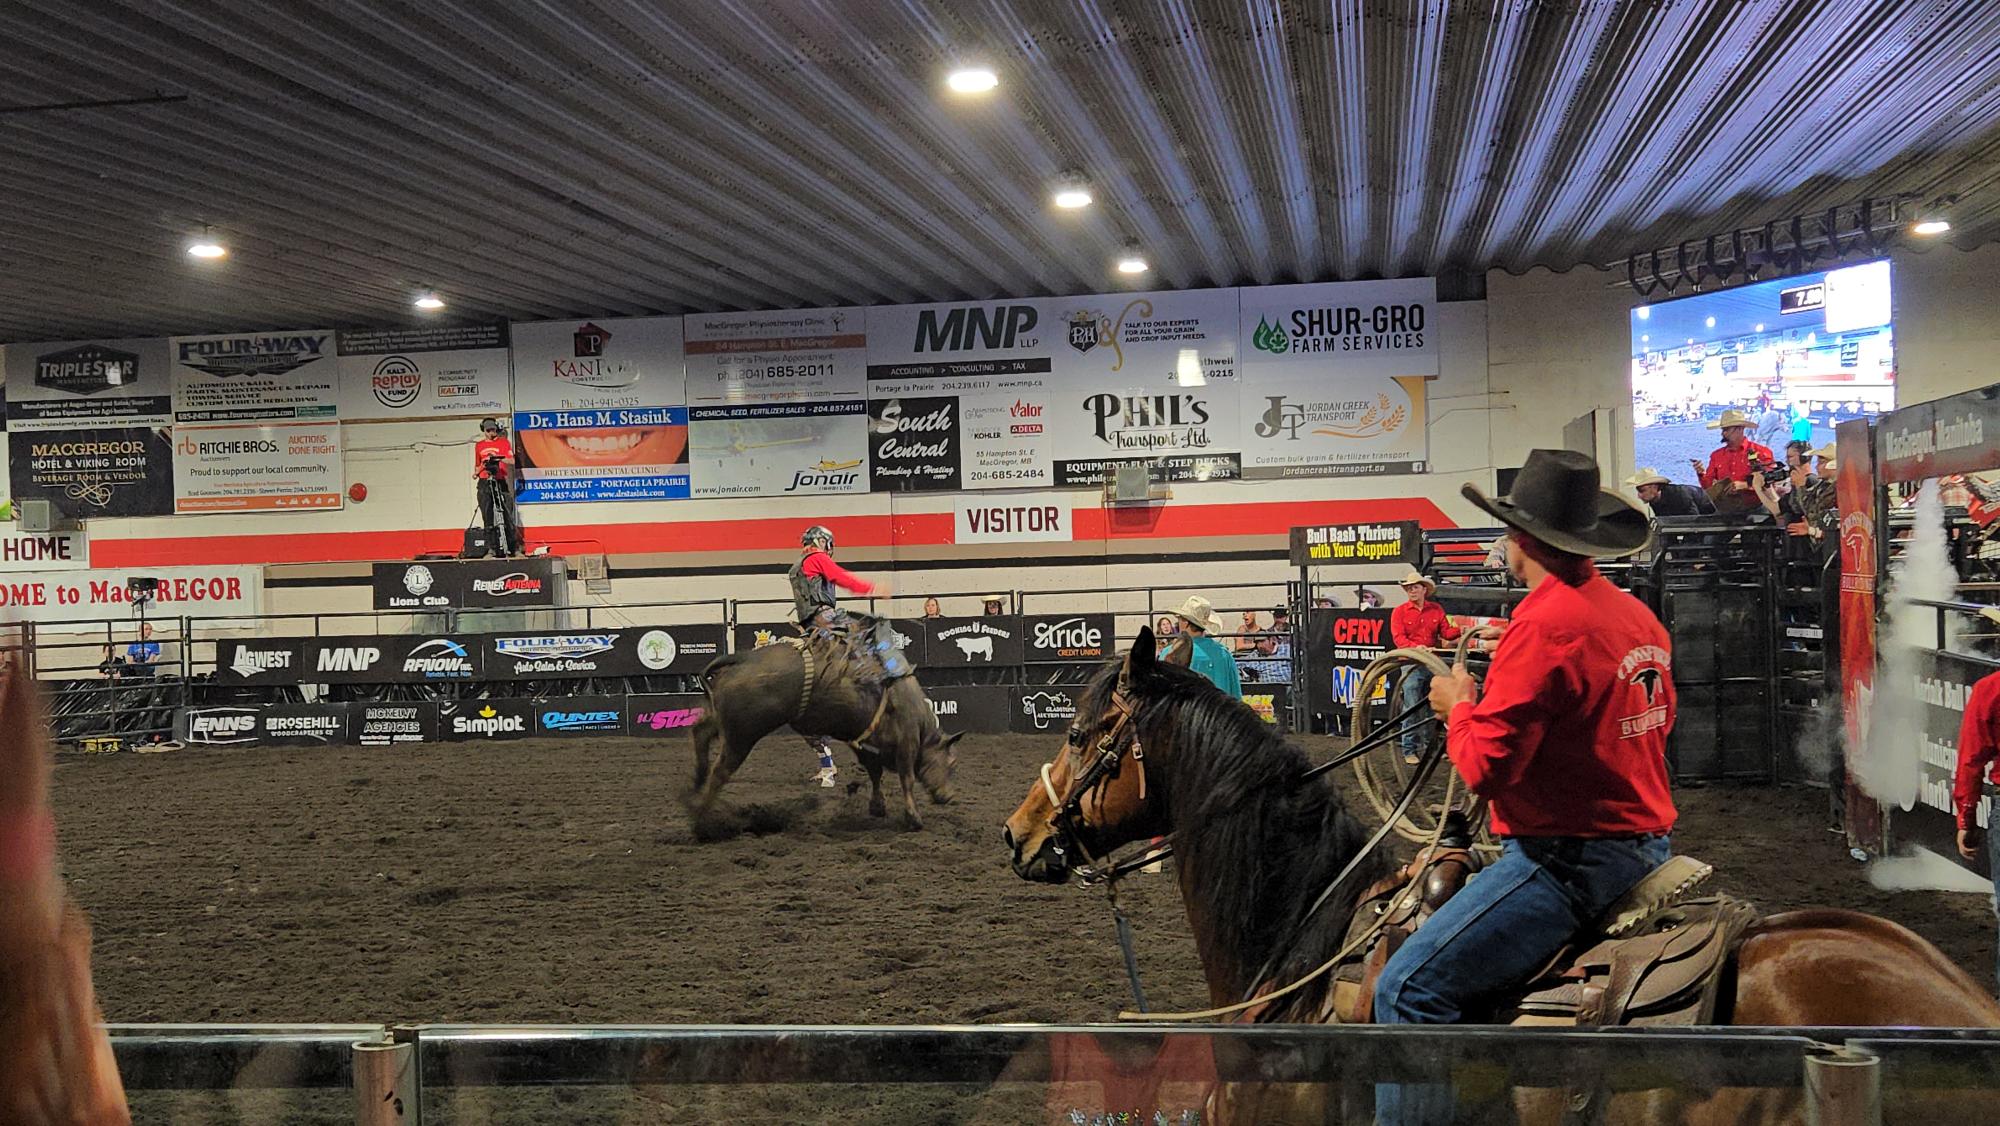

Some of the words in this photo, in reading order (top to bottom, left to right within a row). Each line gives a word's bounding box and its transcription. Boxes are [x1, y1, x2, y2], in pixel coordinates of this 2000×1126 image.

[1169, 319, 1200, 327] EXPERTS
[1291, 304, 1425, 338] SHUR-GRO
[913, 305, 1038, 352] MNP
[589, 335, 601, 353] P
[1020, 339, 1039, 348] LLP
[1293, 338, 1335, 354] FARM
[1342, 333, 1424, 351] SERVICES
[40, 362, 91, 378] TRIPLE
[767, 364, 834, 378] 685-2011
[891, 366, 935, 376] ACCOUNTING
[951, 364, 995, 373] CONSULTING
[1012, 362, 1026, 370] TAX
[875, 385, 901, 394] Portage
[750, 407, 784, 415] FERTILIZER
[786, 406, 806, 414] SALES
[1010, 398, 1043, 417] Valor
[1306, 402, 1341, 412] JORDAN
[1343, 401, 1370, 411] CREEK
[528, 414, 552, 428] Dr.
[556, 412, 592, 427] Hans
[595, 412, 616, 426] M.
[620, 409, 671, 425] Stasiuk
[877, 404, 952, 434] South
[1306, 412, 1355, 422] TRANSPORT
[288, 435, 327, 444] AUCTIONS
[974, 432, 1001, 440] KOHLER
[1109, 431, 1178, 451] Transport
[1181, 428, 1211, 448] Ltd.
[31, 441, 146, 457] MACGREGOR
[200, 441, 241, 455] RITCHIE
[243, 440, 280, 453] BROS.
[288, 446, 311, 455] DONE
[878, 438, 949, 460] Central
[32, 458, 62, 470] HOTEL
[65, 459, 73, 468] &
[75, 458, 110, 468] VIKING
[115, 456, 147, 467] ROOM
[1168, 458, 1192, 467] STEP
[1194, 457, 1230, 467] DECKS
[1255, 456, 1286, 464] Custom
[32, 473, 74, 482] BEVERAGE
[113, 472, 147, 480] VENDOR
[190, 467, 211, 477] Proud
[213, 467, 220, 475] to
[222, 465, 251, 477] support
[252, 466, 264, 474] our
[265, 464, 283, 474] local
[285, 463, 329, 475] community.
[596, 467, 629, 475] DENTAL
[631, 466, 660, 474] CLINIC
[971, 470, 1044, 481] 204-685-2484
[533, 481, 553, 490] SASK
[554, 480, 571, 489] AVE
[572, 480, 592, 488] EAST
[601, 479, 639, 488] PORTAGE
[641, 478, 650, 487] LA
[652, 478, 687, 487] PRAIRIE
[967, 507, 1060, 533] VISITOR
[1307, 528, 1327, 544] Bull
[1330, 527, 1356, 543] Bash
[1358, 525, 1401, 542] Thrives
[4, 537, 71, 561] HOME
[1310, 543, 1331, 559] with
[1333, 542, 1355, 558] Your
[1356, 540, 1401, 560] Support!
[57, 585, 80, 604] to
[89, 577, 242, 603] MacREGOR
[505, 579, 541, 590] ANTENNA
[390, 597, 420, 607] Lions
[423, 596, 449, 606] Club
[937, 624, 972, 641] ROCKING
[981, 624, 1010, 639] FEEDERS
[1034, 618, 1101, 649] Stride
[1334, 618, 1383, 645] CFRY
[234, 645, 292, 668] AGWEST
[1057, 648, 1080, 657] CREDIT
[1080, 648, 1101, 657] UNION
[317, 648, 380, 672] MNP
[403, 658, 464, 672] RFNOW
[514, 661, 534, 675] Auto
[534, 661, 556, 672] Sales
[556, 661, 564, 671] &
[565, 660, 597, 671] Services
[193, 716, 256, 732] ENNS
[278, 717, 341, 730] ROSEHILL
[453, 714, 525, 736] Simplot
[543, 711, 619, 725] QUINTEX
[363, 722, 420, 733] AGENCIES
